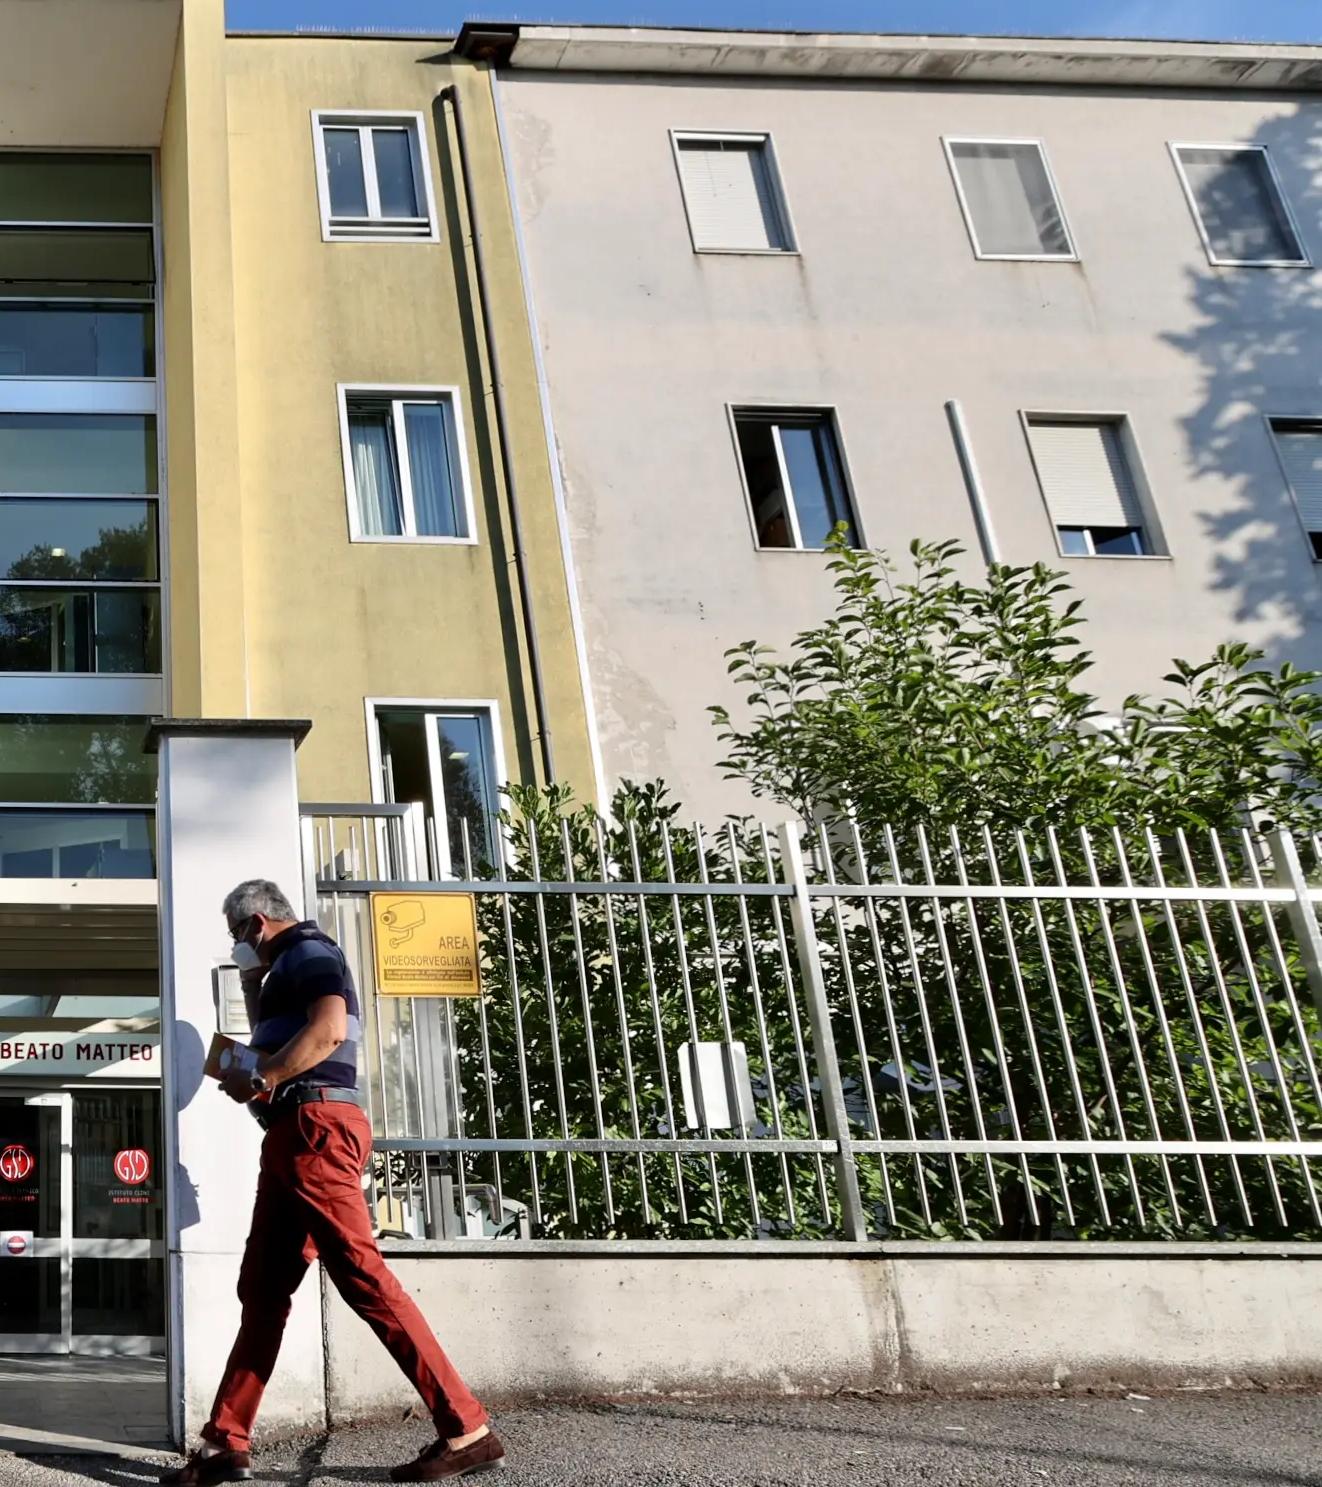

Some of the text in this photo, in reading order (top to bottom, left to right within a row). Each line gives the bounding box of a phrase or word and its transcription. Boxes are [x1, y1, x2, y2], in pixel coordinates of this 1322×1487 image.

[439, 936, 470, 950] AREA
[383, 955, 472, 967] VIDEOSORVEGLIATA
[0, 1042, 64, 1060] BEATO
[76, 1043, 154, 1061] MATTEO
